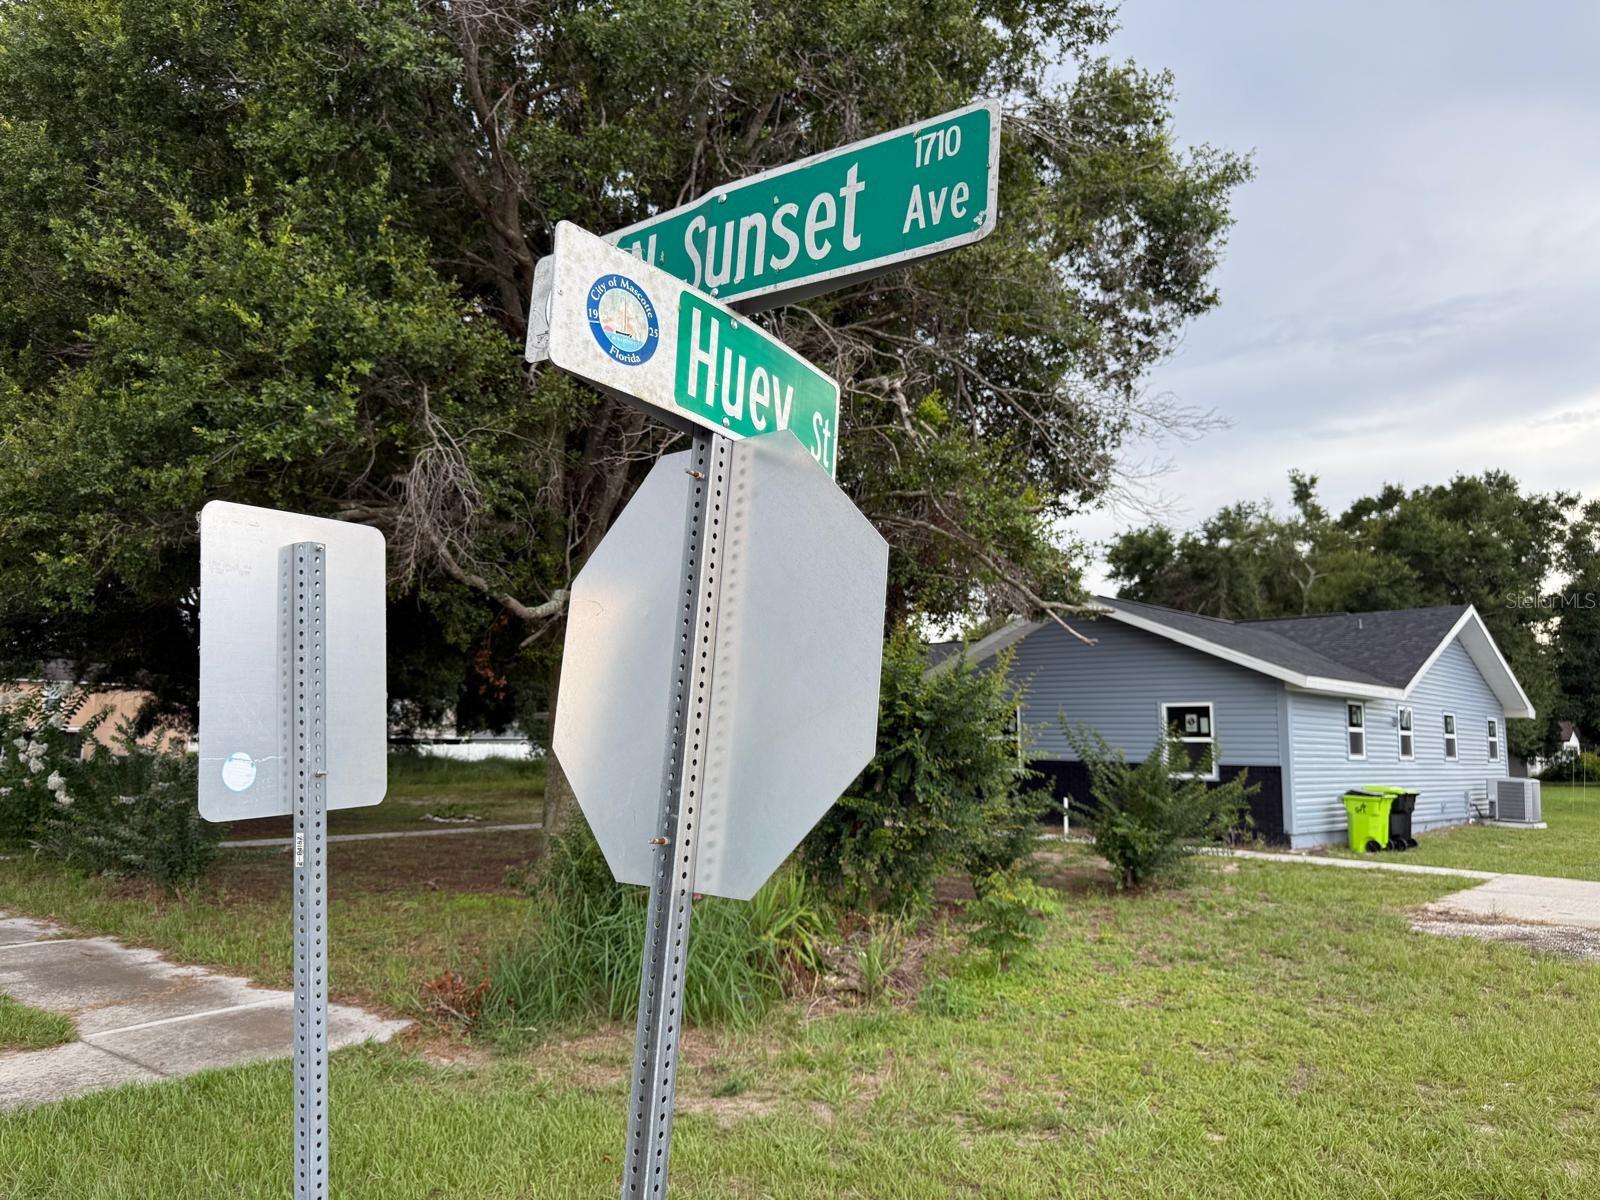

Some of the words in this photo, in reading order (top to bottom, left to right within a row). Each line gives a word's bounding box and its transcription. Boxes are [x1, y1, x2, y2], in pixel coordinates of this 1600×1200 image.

[914, 125, 962, 168] 1710
[682, 162, 866, 290] Sunset
[902, 181, 970, 235] Ave
[588, 308, 599, 319] 19
[590, 283, 607, 301] City
[608, 277, 617, 287] of
[620, 278, 653, 319] Mascotte
[609, 344, 641, 363] Florida
[648, 327, 659, 338] 25
[811, 411, 831, 469] St
